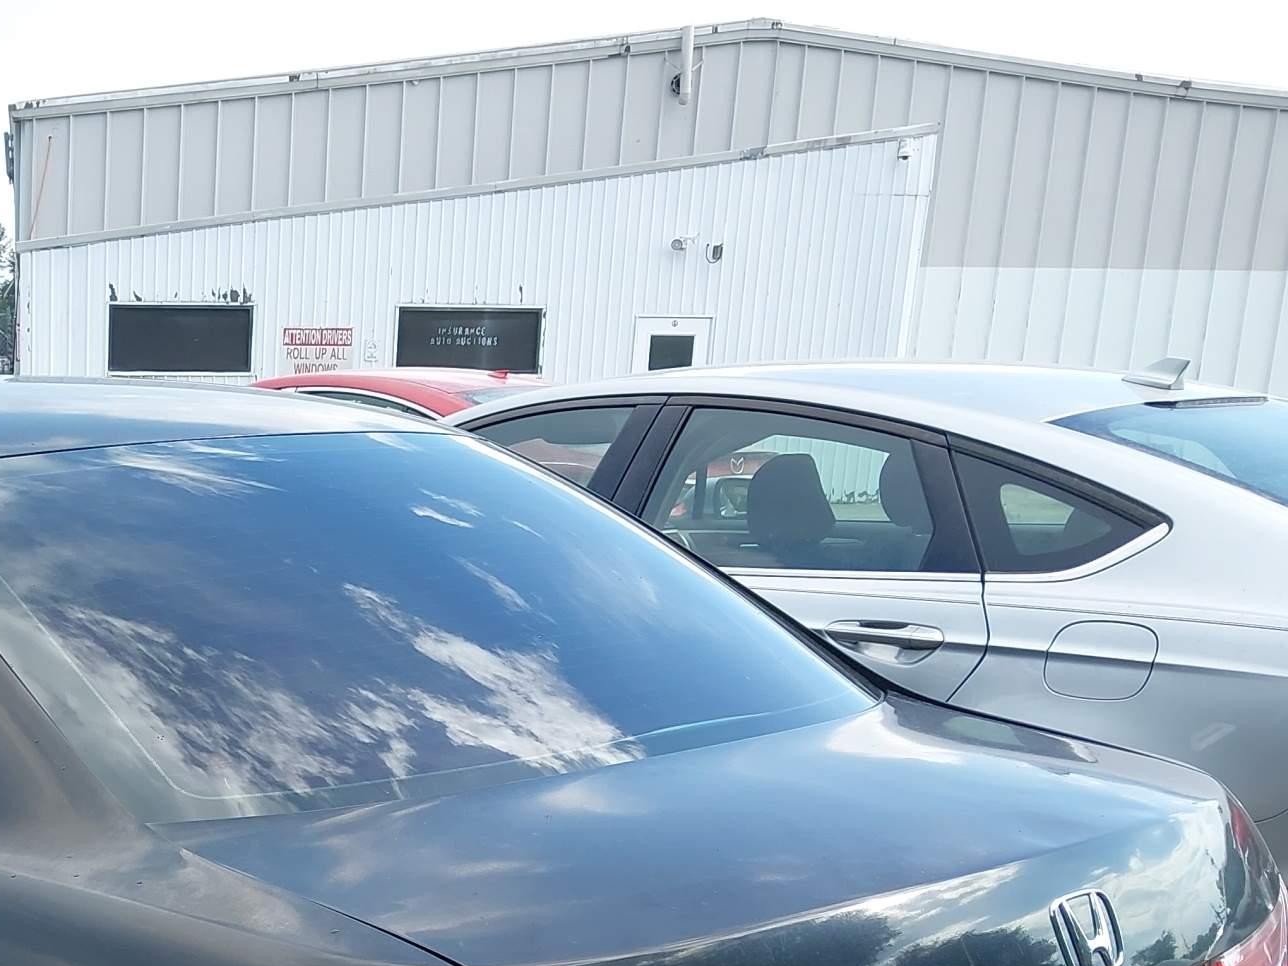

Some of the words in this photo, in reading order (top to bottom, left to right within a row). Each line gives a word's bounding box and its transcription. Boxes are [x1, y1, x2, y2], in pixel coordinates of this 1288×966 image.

[283, 329, 321, 345] ATTENTION
[322, 329, 352, 345] DRIVERS
[438, 325, 486, 336] INSURANCE
[286, 347, 310, 360] ROLL
[314, 347, 327, 360] UP
[329, 347, 348, 361] ALL
